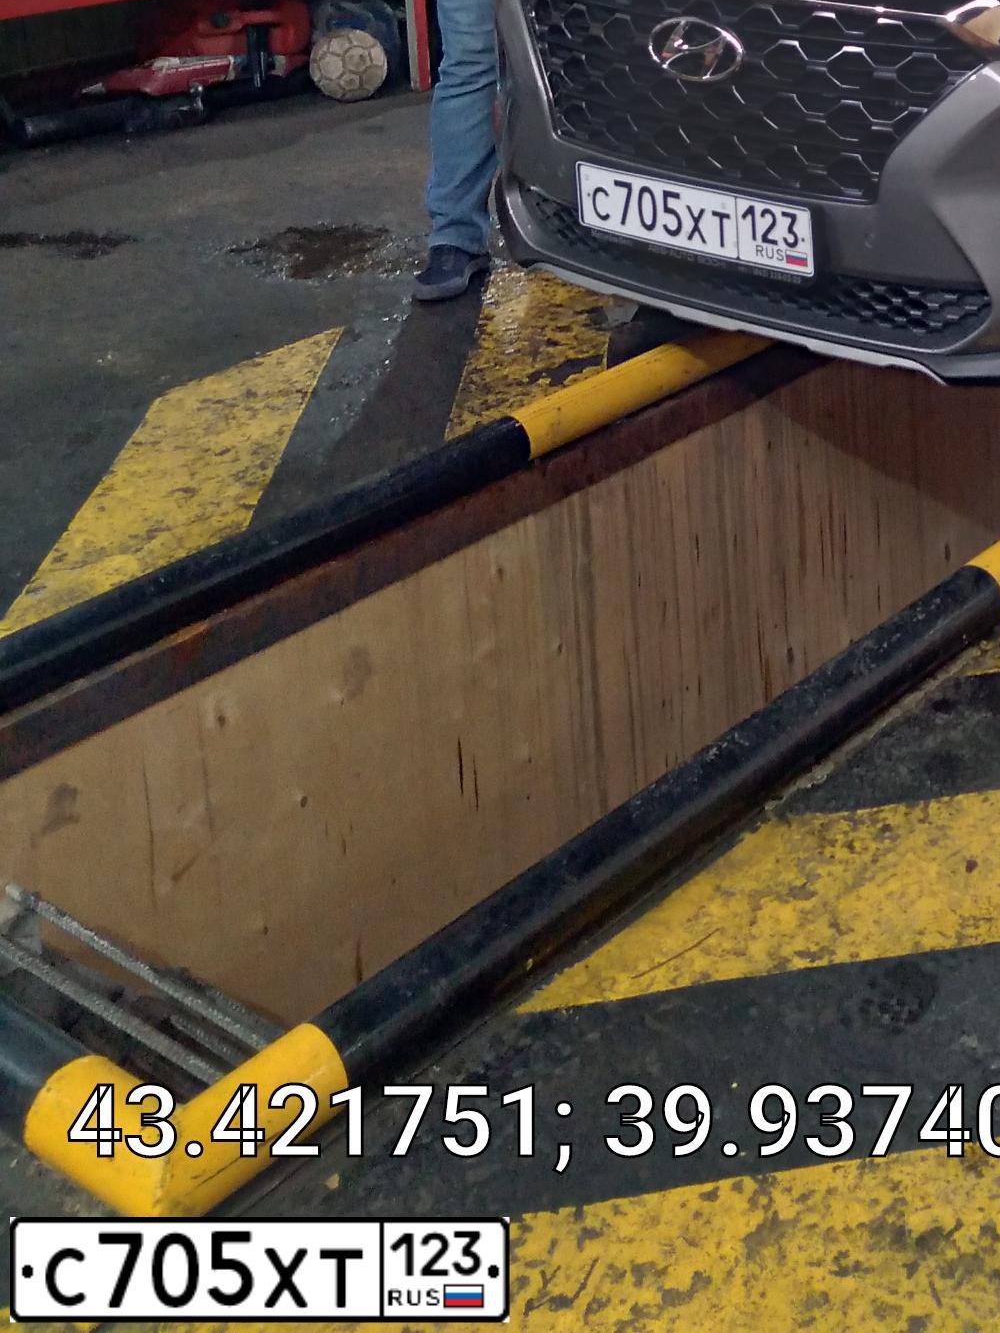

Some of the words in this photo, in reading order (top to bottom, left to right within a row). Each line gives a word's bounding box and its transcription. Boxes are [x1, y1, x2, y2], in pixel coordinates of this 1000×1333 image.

[592, 179, 731, 248] С705ХТ
[742, 205, 798, 248] 123
[755, 244, 785, 262] RUS
